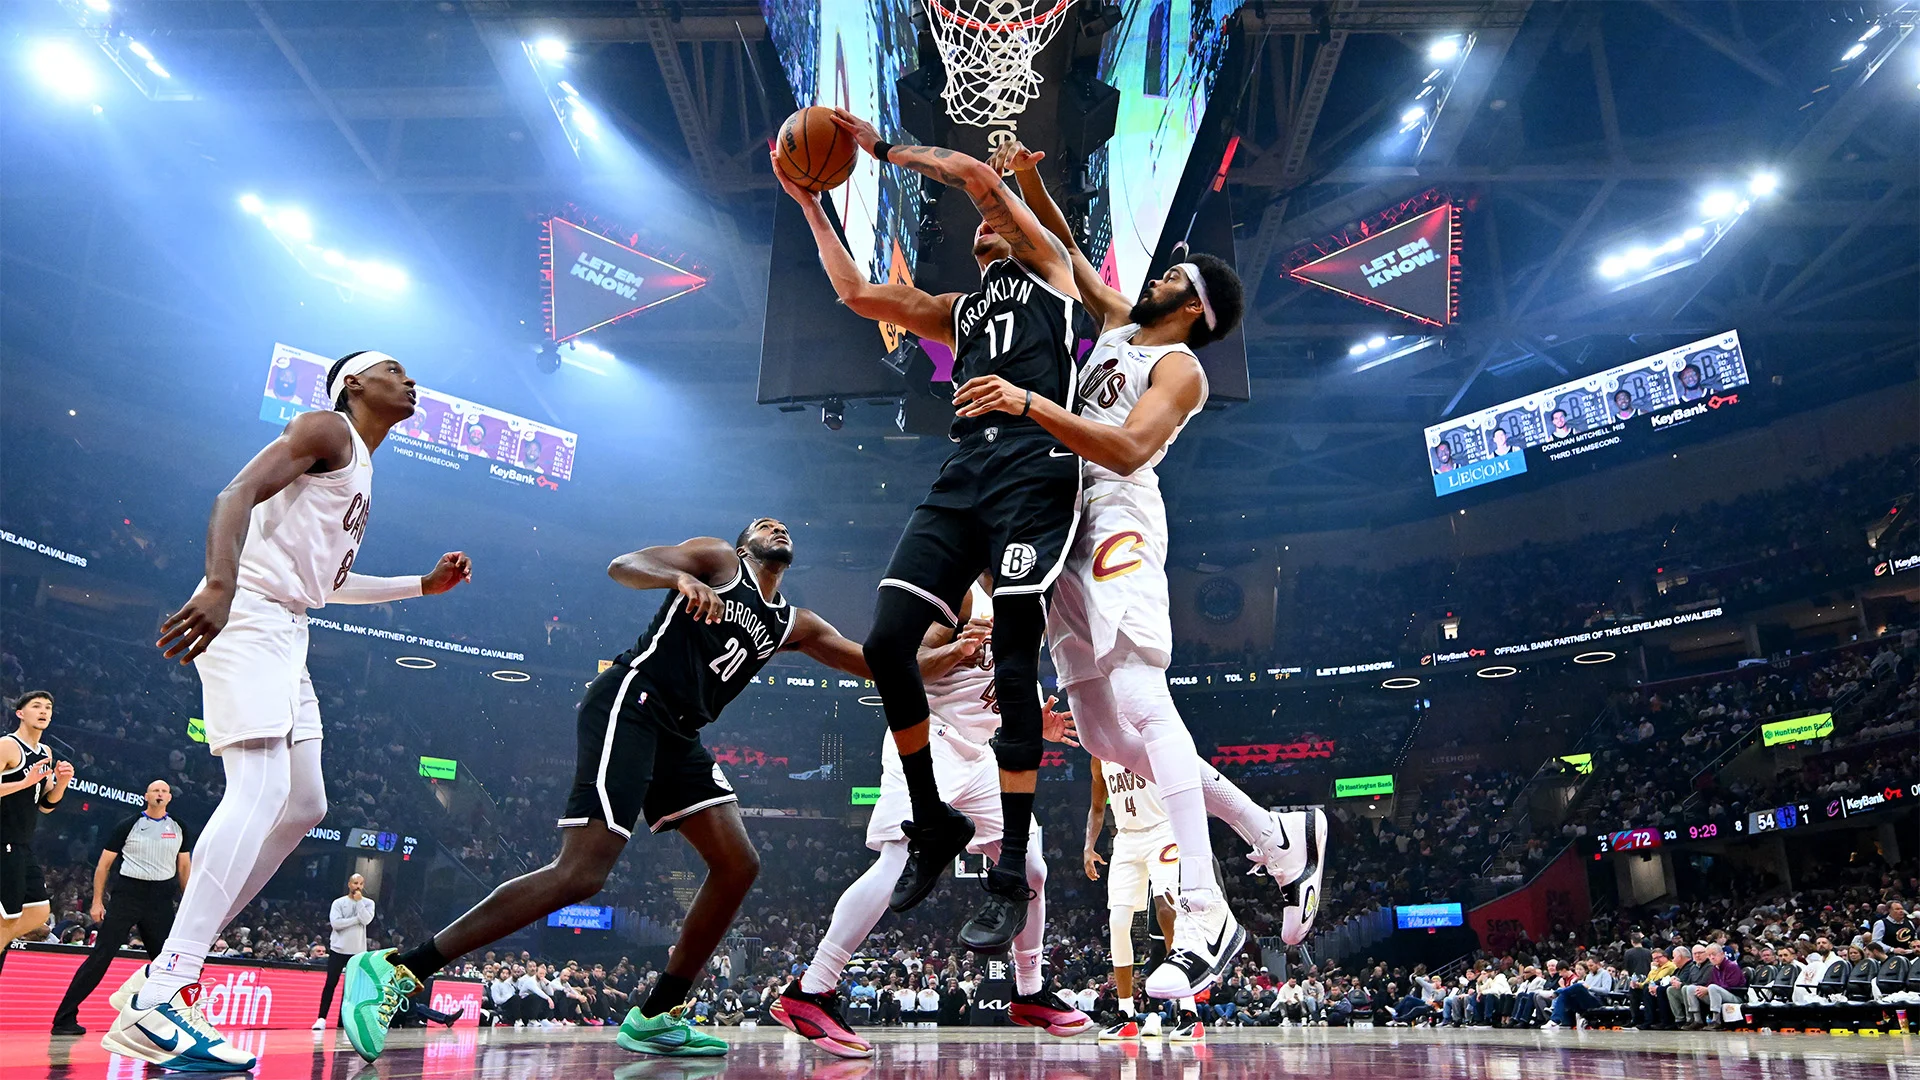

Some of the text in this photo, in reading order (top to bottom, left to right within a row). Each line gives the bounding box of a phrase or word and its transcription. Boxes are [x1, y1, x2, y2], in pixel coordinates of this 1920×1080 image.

[1360, 237, 1430, 276] LET EM
[577, 251, 645, 288] LET EM
[1366, 249, 1442, 288] KNOW.
[569, 263, 638, 301] KNOW.
[984, 311, 1015, 360] 17
[1723, 337, 1734, 345] 30
[1653, 359, 1664, 367] 20
[1079, 362, 1126, 409] VS
[1650, 402, 1708, 427] KeyBank
[389, 433, 422, 448] DONOVAN
[457, 452, 469, 461] HIS
[1541, 438, 1575, 452] DONOVAN
[1612, 422, 1625, 432] HIS
[490, 463, 535, 485] KeyBank
[0, 529, 88, 568] VELAND CAVALIERS
[333, 549, 354, 591] 8
[307, 616, 524, 662] OFFICIAL BANK PARTNER OF THE CLEVELAND CAVALIERS
[724, 600, 773, 660] BROOKLYN
[1437, 651, 1469, 662] KeyBank
[1494, 644, 1530, 656] OFFICIAL
[1530, 639, 1553, 650] BANK
[1554, 633, 1591, 646] PARTNER
[1592, 631, 1603, 640] OF
[1604, 627, 1622, 638] THE
[1621, 617, 1672, 634] CLEVELAND
[1673, 608, 1723, 625] CAVALIERS
[709, 637, 748, 682] 20
[1316, 661, 1395, 677] LET EM KNOW.
[750, 676, 775, 685] OL 5
[787, 677, 828, 688] FOULS 2
[838, 679, 875, 688] FG% 51
[1170, 675, 1211, 685] FOULS 1
[1225, 672, 1256, 683] TOL 5
[1774, 725, 1812, 737] Huntington
[34, 783, 41, 804] 8
[1108, 772, 1146, 795] CAVS
[1345, 783, 1377, 791] Huntington
[99, 785, 145, 807] CAVALIERS
[1125, 796, 1137, 817] 4
[1847, 792, 1885, 810] KeyBank
[1803, 813, 1809, 824] 1
[305, 828, 341, 841] OUNDS
[360, 834, 376, 847] 26
[1633, 832, 1651, 847] 72
[1664, 830, 1677, 840] 3Q
[1689, 823, 1717, 839] 9:29
[1735, 820, 1743, 831] 8
[1758, 813, 1775, 830] 54
[403, 845, 414, 855] 37
[1601, 842, 1608, 852] 2
[10, 941, 27, 950] anc
[202, 972, 272, 1026] dfin
[445, 993, 479, 1020] Redfin
